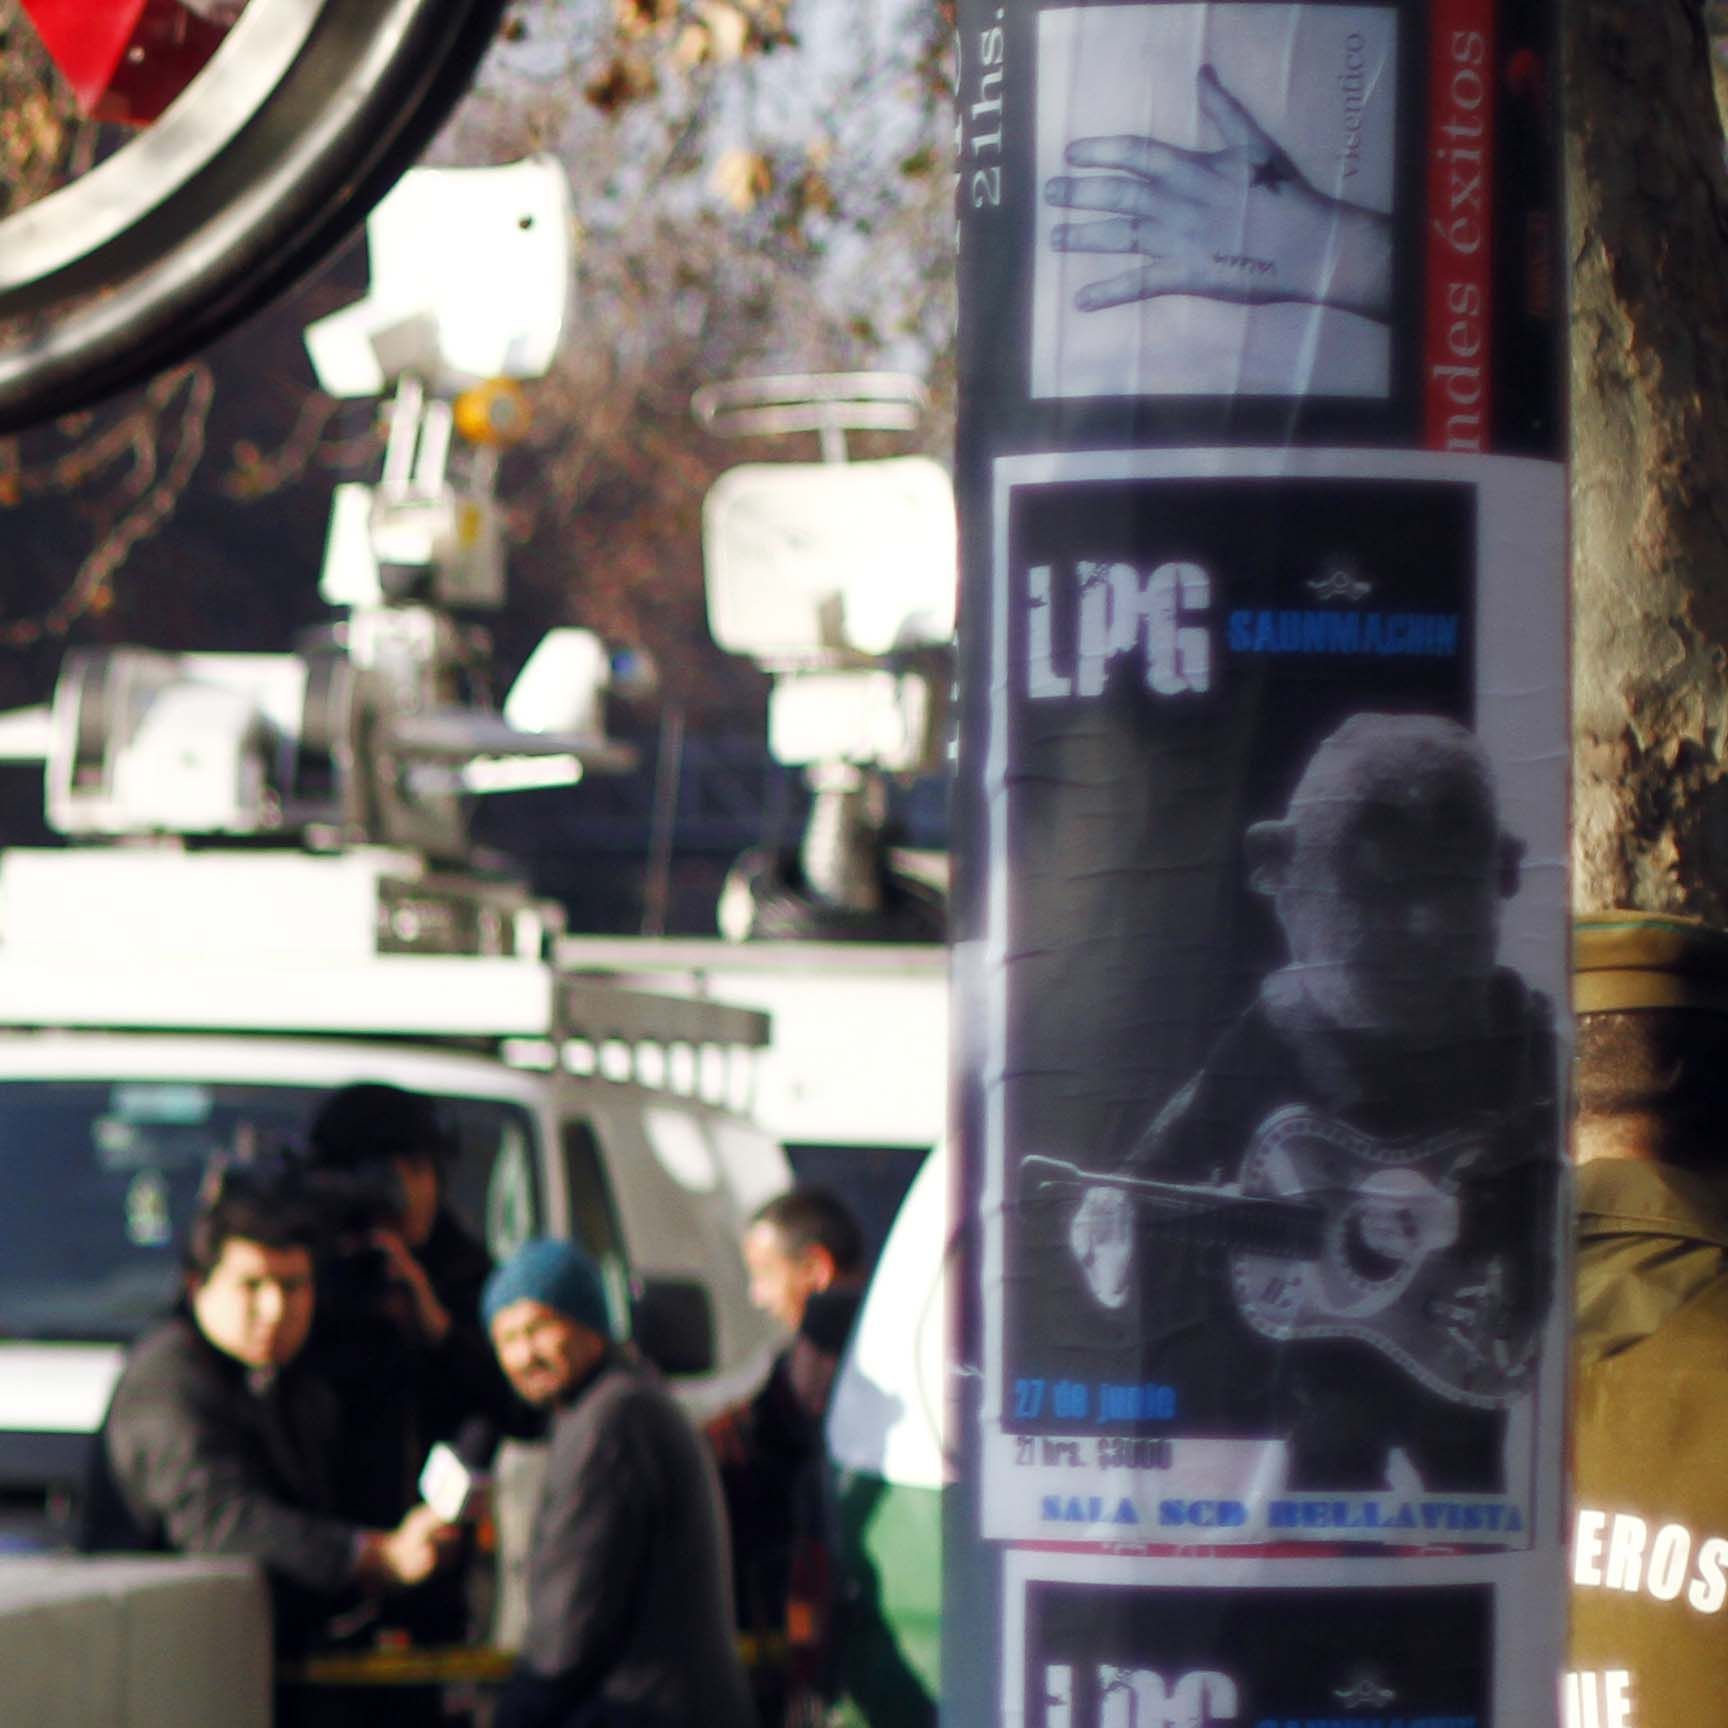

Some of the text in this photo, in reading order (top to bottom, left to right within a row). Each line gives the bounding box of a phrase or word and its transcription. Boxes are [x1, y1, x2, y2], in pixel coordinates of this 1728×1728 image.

[971, 8, 1004, 208] 21hs.
[1432, 30, 1486, 450] ndes éxitos
[1028, 561, 1212, 698] LPG
[1014, 1378, 1046, 1419] 27
[1041, 1495, 1523, 1531] SALA SCD BELLAVISTA
[1573, 1508, 1728, 1615] EROS
